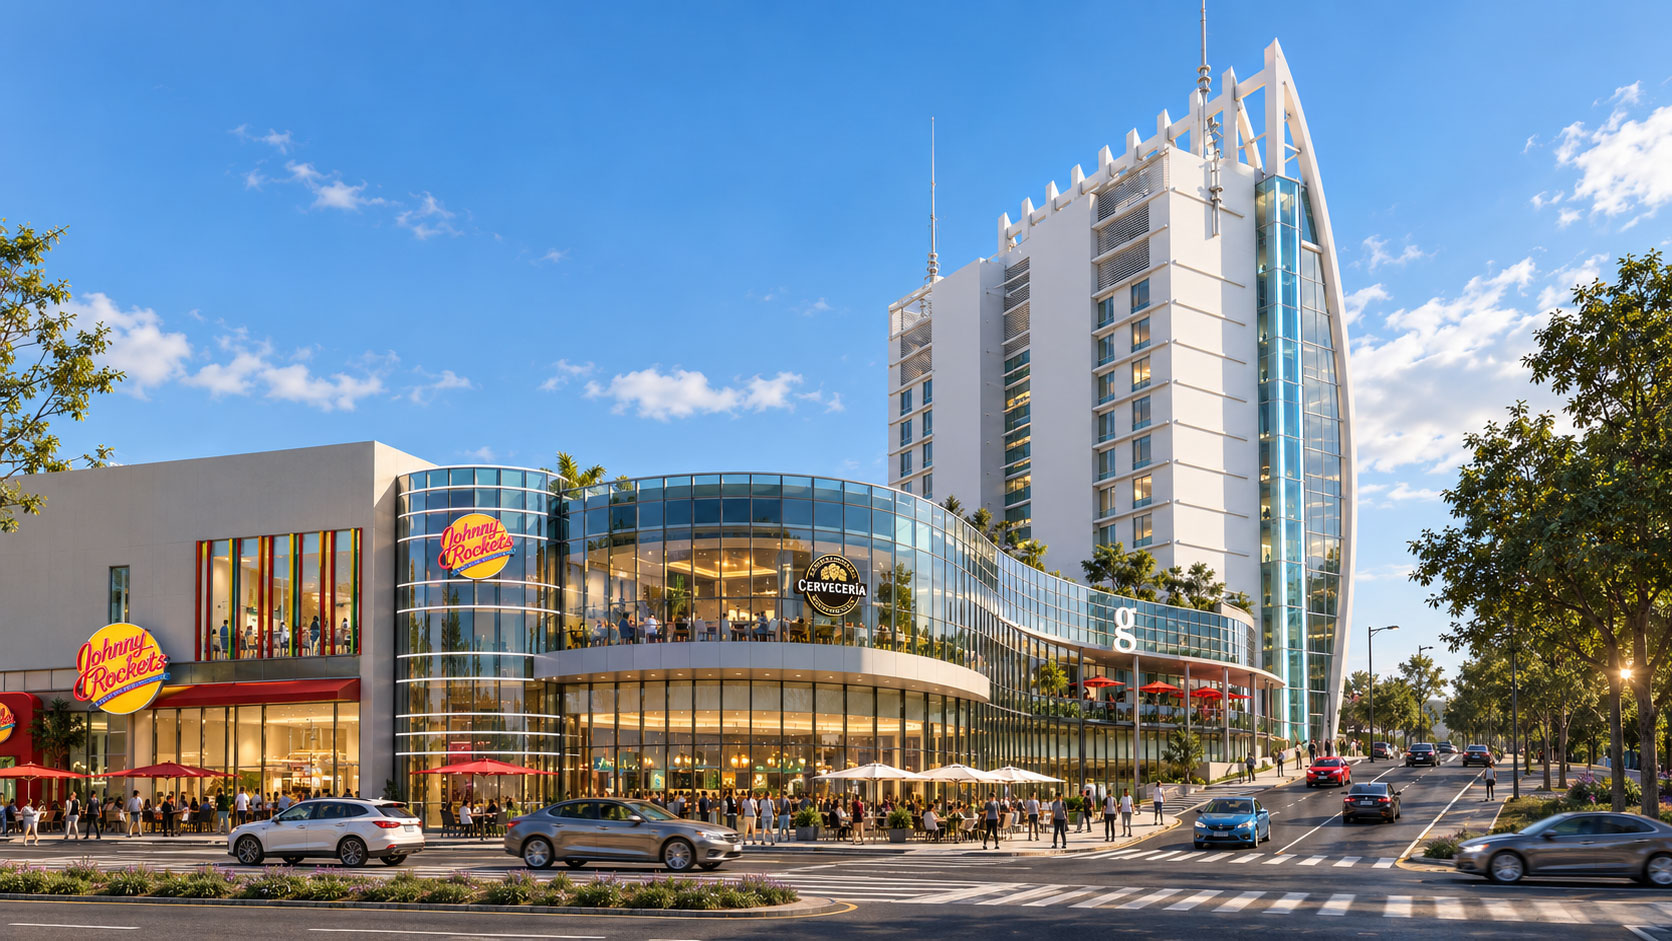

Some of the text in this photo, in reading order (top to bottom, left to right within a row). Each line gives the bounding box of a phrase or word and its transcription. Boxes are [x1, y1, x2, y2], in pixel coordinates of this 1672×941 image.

[438, 534, 514, 569] Rockets
[440, 519, 505, 566] Johnny
[798, 579, 866, 595] CERVECERÍA
[1113, 606, 1137, 653] g
[73, 652, 169, 701] Rockets
[76, 628, 154, 696] Johnny
